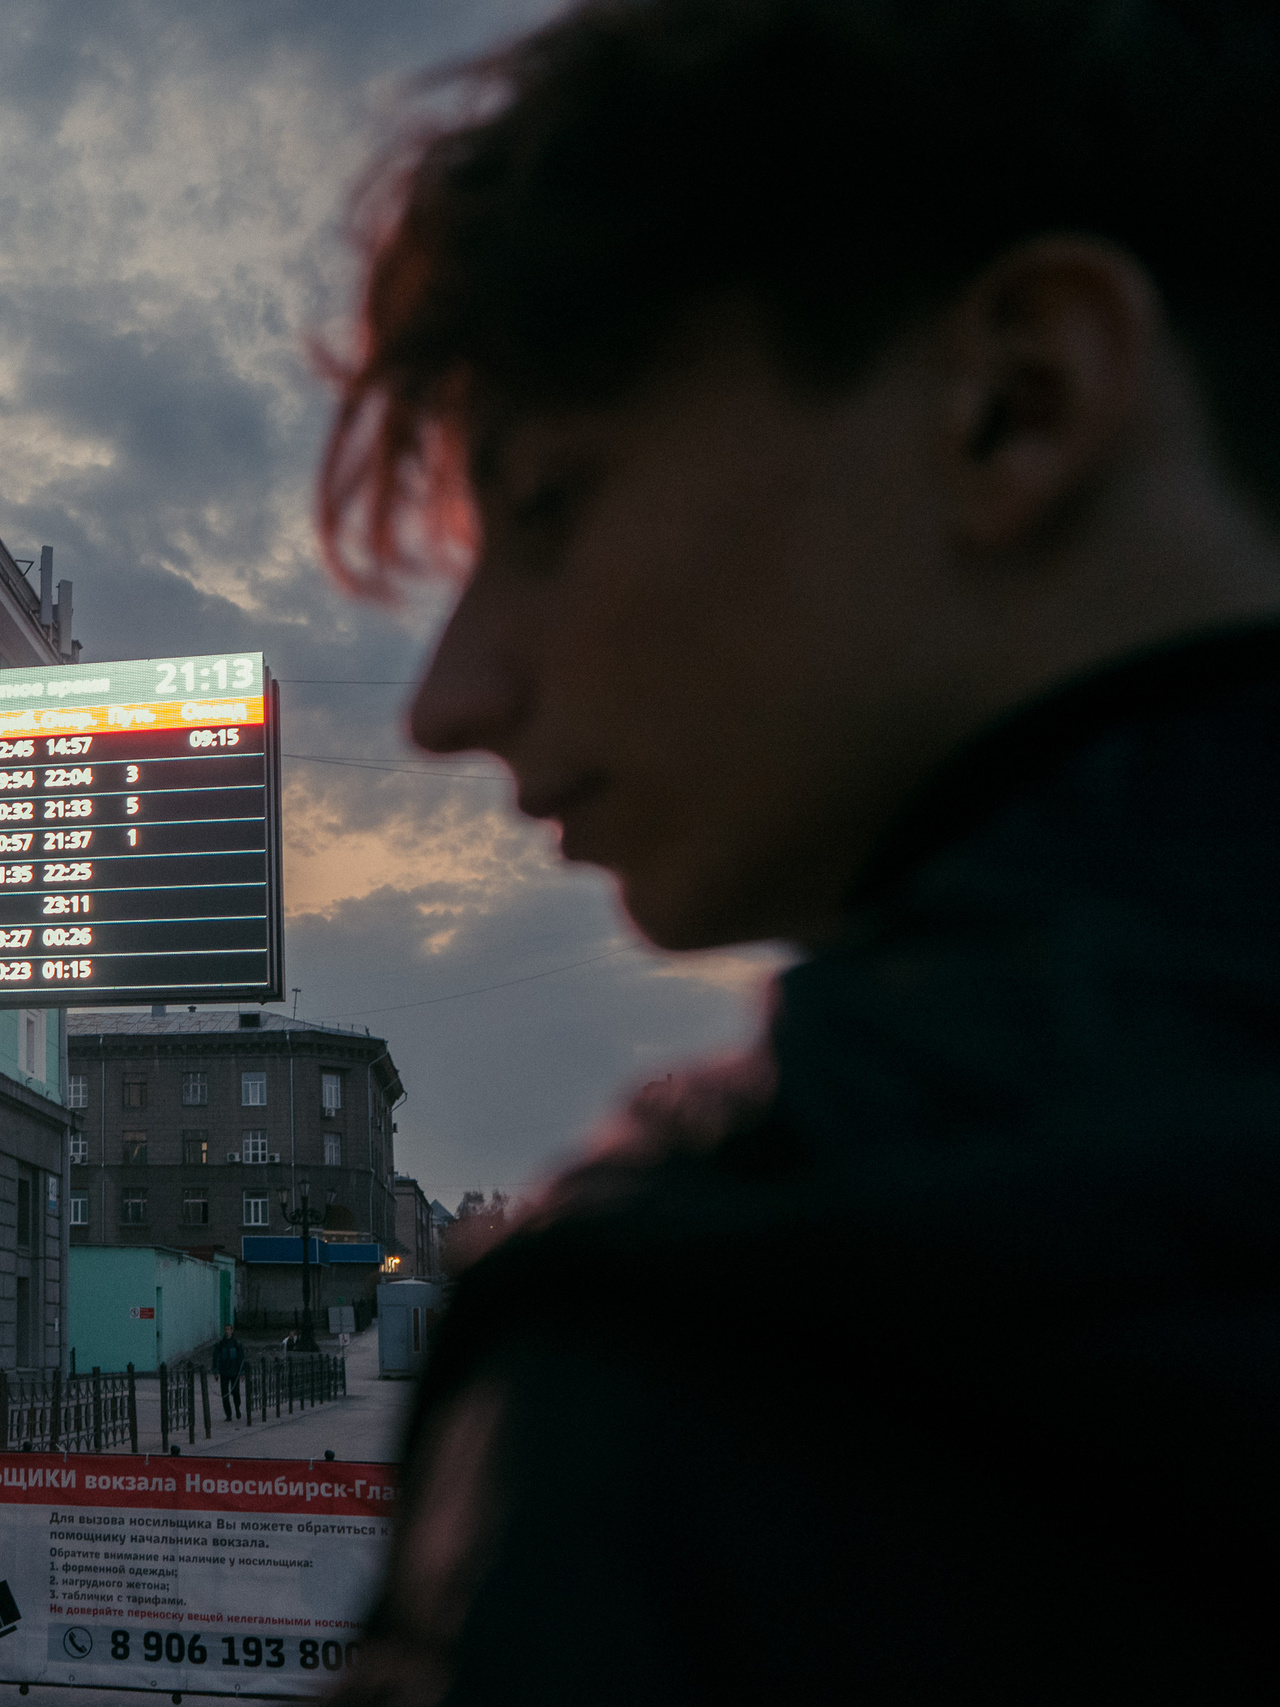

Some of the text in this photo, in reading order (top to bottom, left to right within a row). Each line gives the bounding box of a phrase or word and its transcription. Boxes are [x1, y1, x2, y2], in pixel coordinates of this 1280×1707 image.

[155, 659, 254, 694] 21:13
[46, 737, 92, 755] 14:57
[190, 729, 239, 747] 09:15
[44, 768, 92, 787] 22:04
[127, 766, 137, 782] 3
[44, 800, 91, 818] 21:33
[127, 797, 138, 814] 5
[44, 831, 91, 850] 21:37
[128, 829, 136, 846] 1
[43, 863, 91, 882] 22:25
[43, 895, 89, 914] 23:11
[43, 928, 91, 946] 00:26
[42, 961, 90, 979] 01:15
[85, 1472, 176, 1493] вокзала
[185, 1473, 398, 1502] Новосибирск-Гла
[49, 1512, 75, 1526] Для
[79, 1515, 125, 1526] вызова
[129, 1516, 212, 1531] носильщика
[216, 1518, 236, 1530] Вы
[241, 1521, 293, 1532] можете
[298, 1521, 376, 1536] обратиться
[49, 1531, 270, 1549] помощнику начальника вокзала.
[49, 1548, 314, 1569] Обратите внимание на наличие у носильщика:
[49, 1562, 178, 1578] 1. форменной одежды;
[49, 1576, 170, 1592] 2. нагрудного жетона;
[49, 1589, 187, 1607] 3. таблички с тарифами.
[49, 1604, 64, 1616] Не
[66, 1606, 124, 1619] доверяйте
[127, 1609, 184, 1622] переноску
[187, 1611, 224, 1624] вещей
[226, 1614, 312, 1627] нелегальными
[111, 1629, 131, 1660] 8
[143, 1631, 208, 1664] 906
[221, 1636, 286, 1668] 193
